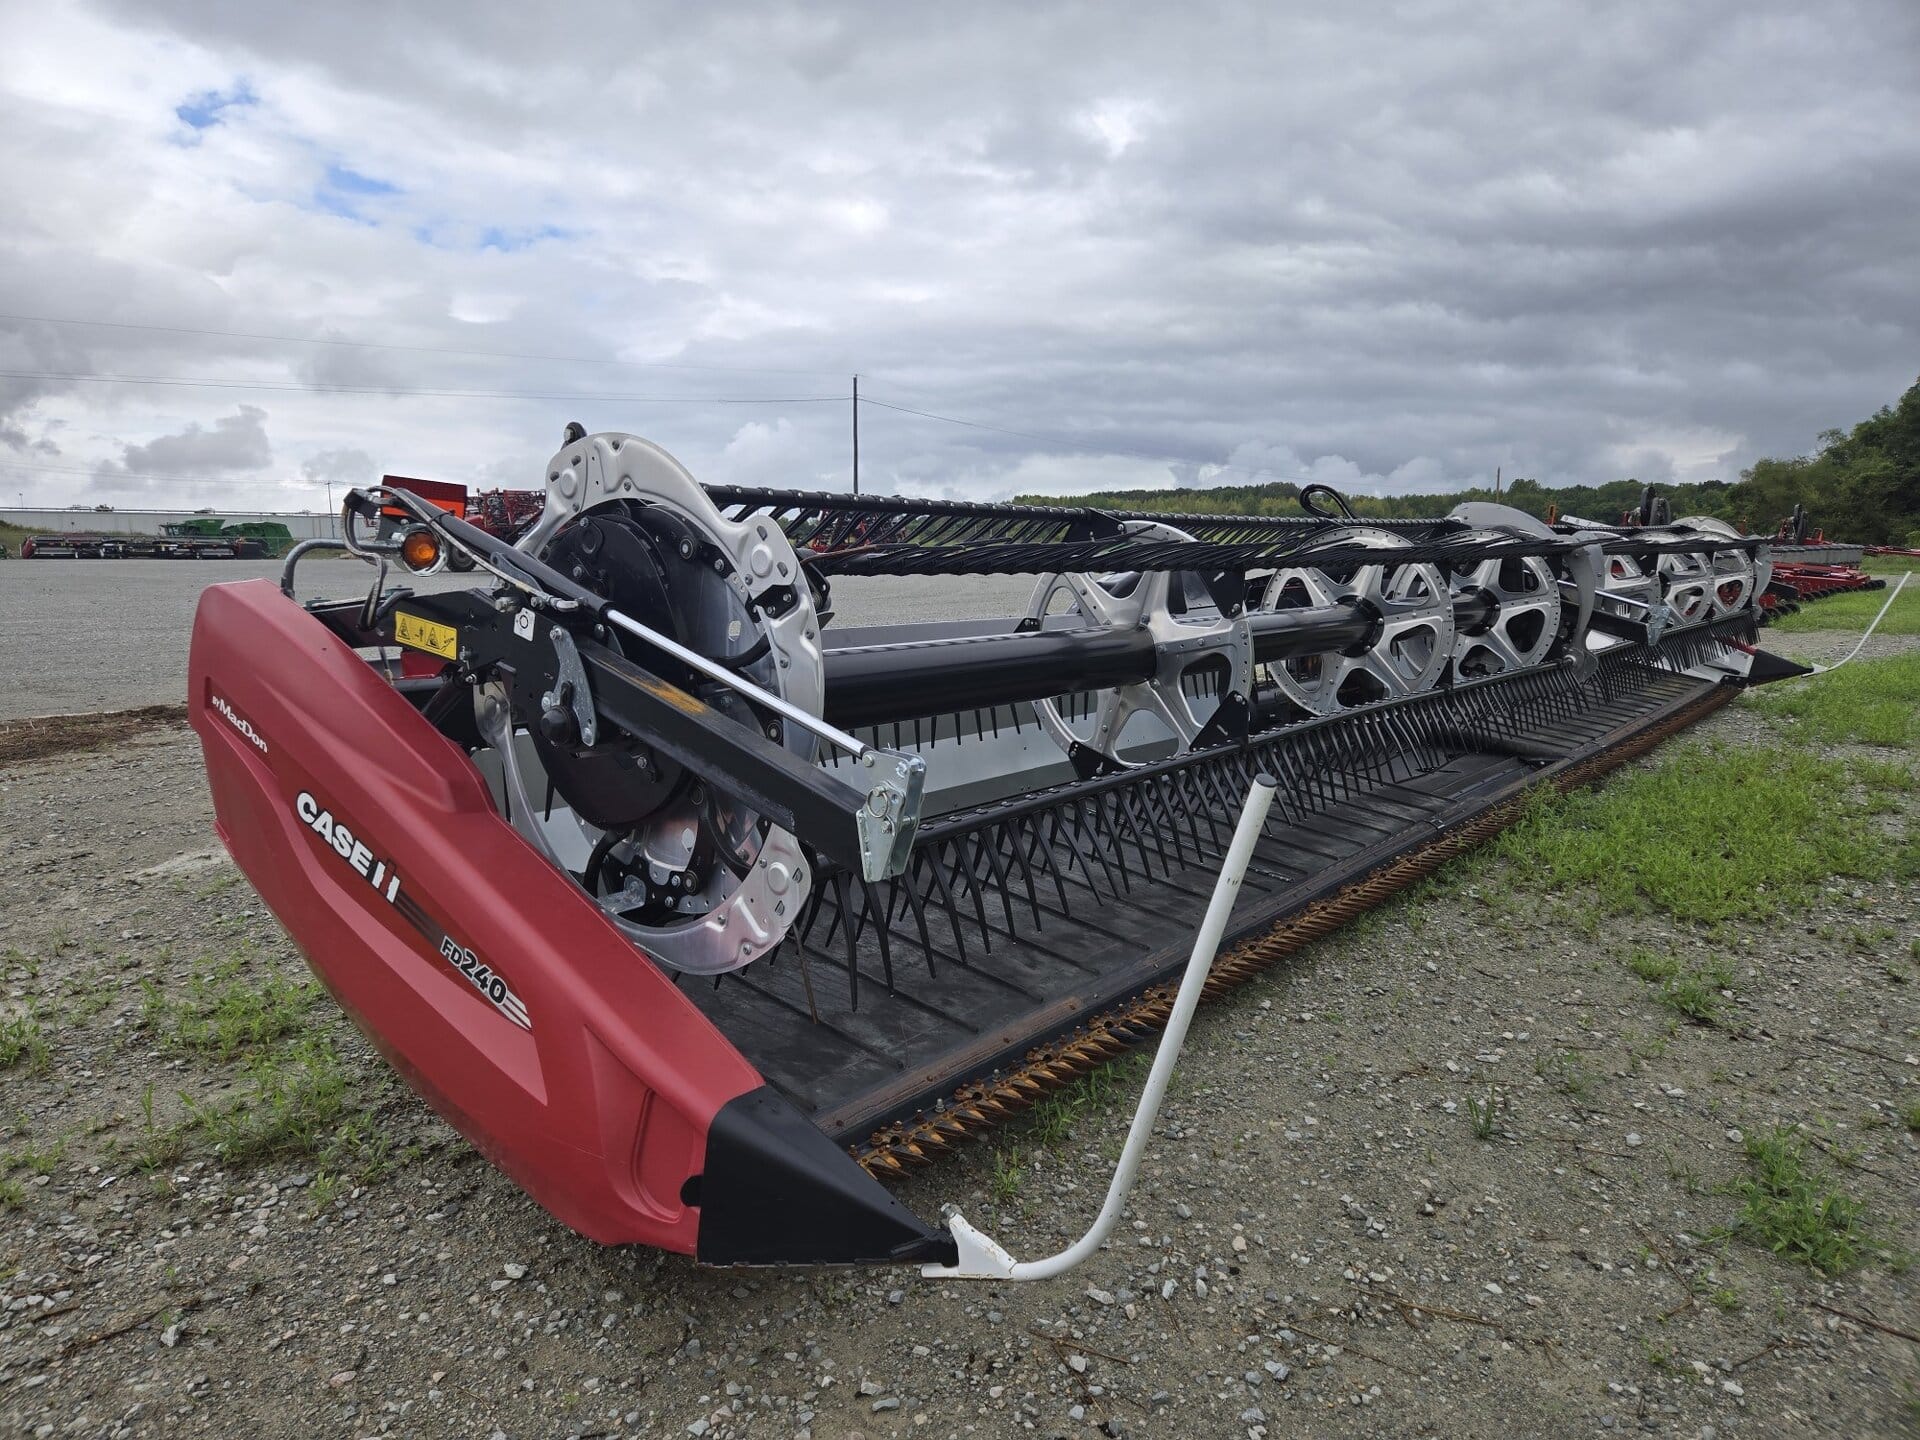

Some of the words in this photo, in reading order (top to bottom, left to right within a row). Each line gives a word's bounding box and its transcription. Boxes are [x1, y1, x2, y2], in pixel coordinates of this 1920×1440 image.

[219, 698, 268, 753] MacDon
[296, 792, 374, 877] CASE
[441, 936, 508, 1006] FD240
